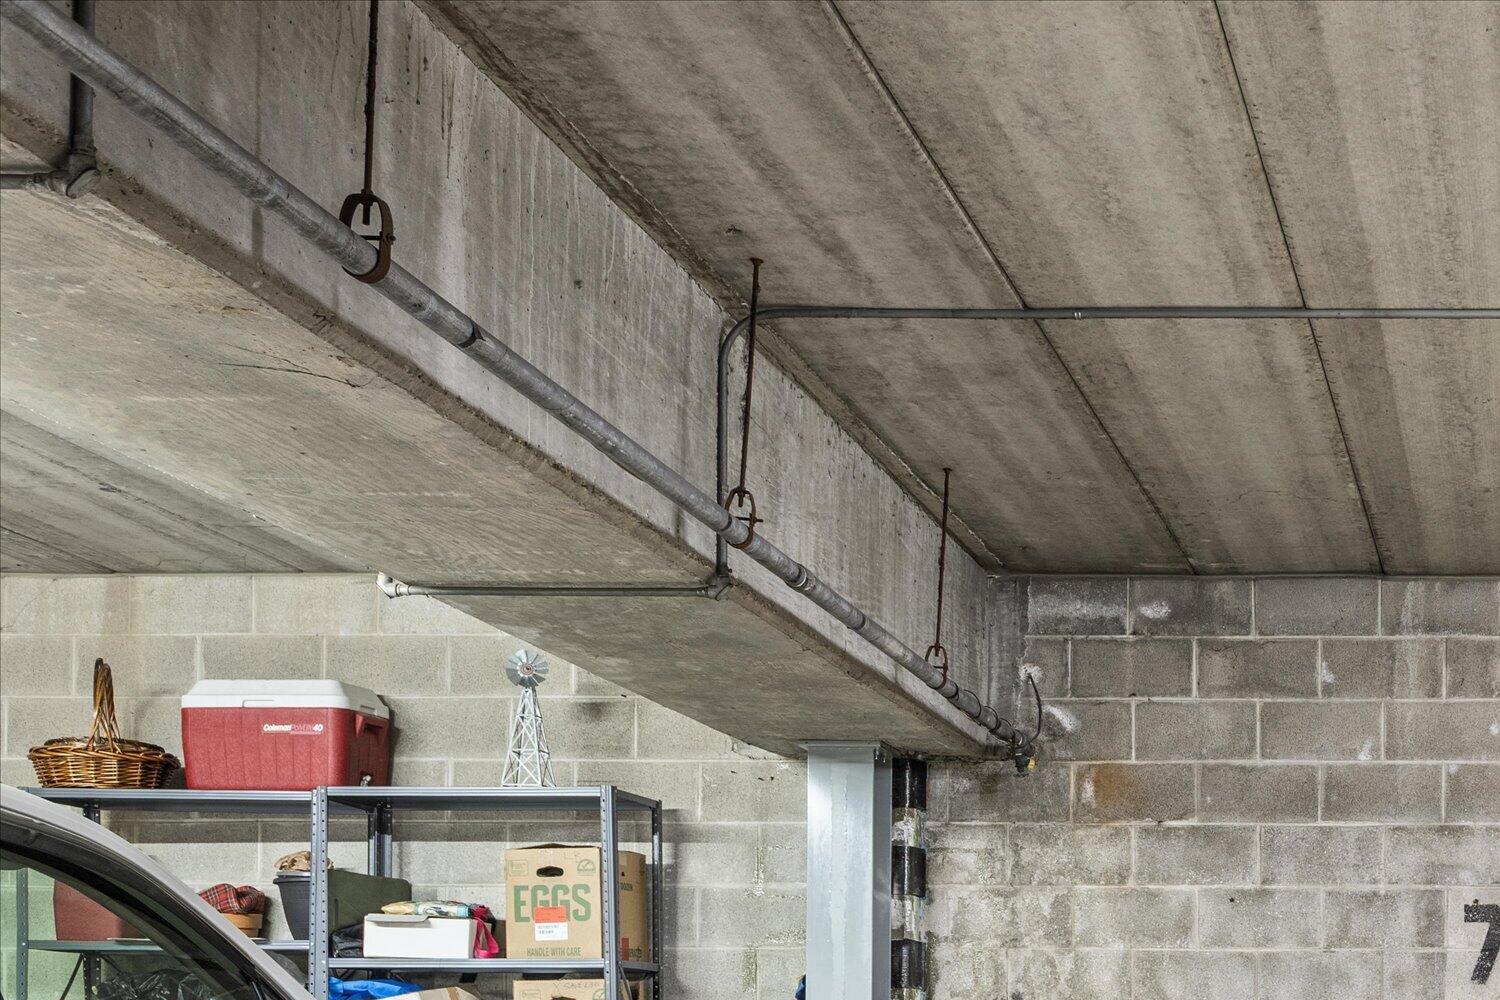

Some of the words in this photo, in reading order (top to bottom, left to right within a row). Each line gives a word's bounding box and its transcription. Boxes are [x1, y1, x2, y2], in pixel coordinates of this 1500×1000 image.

[513, 884, 592, 923] EGGS
[526, 947, 549, 957] HANDLE
[550, 947, 565, 957] WITH
[566, 946, 582, 957] CARE
